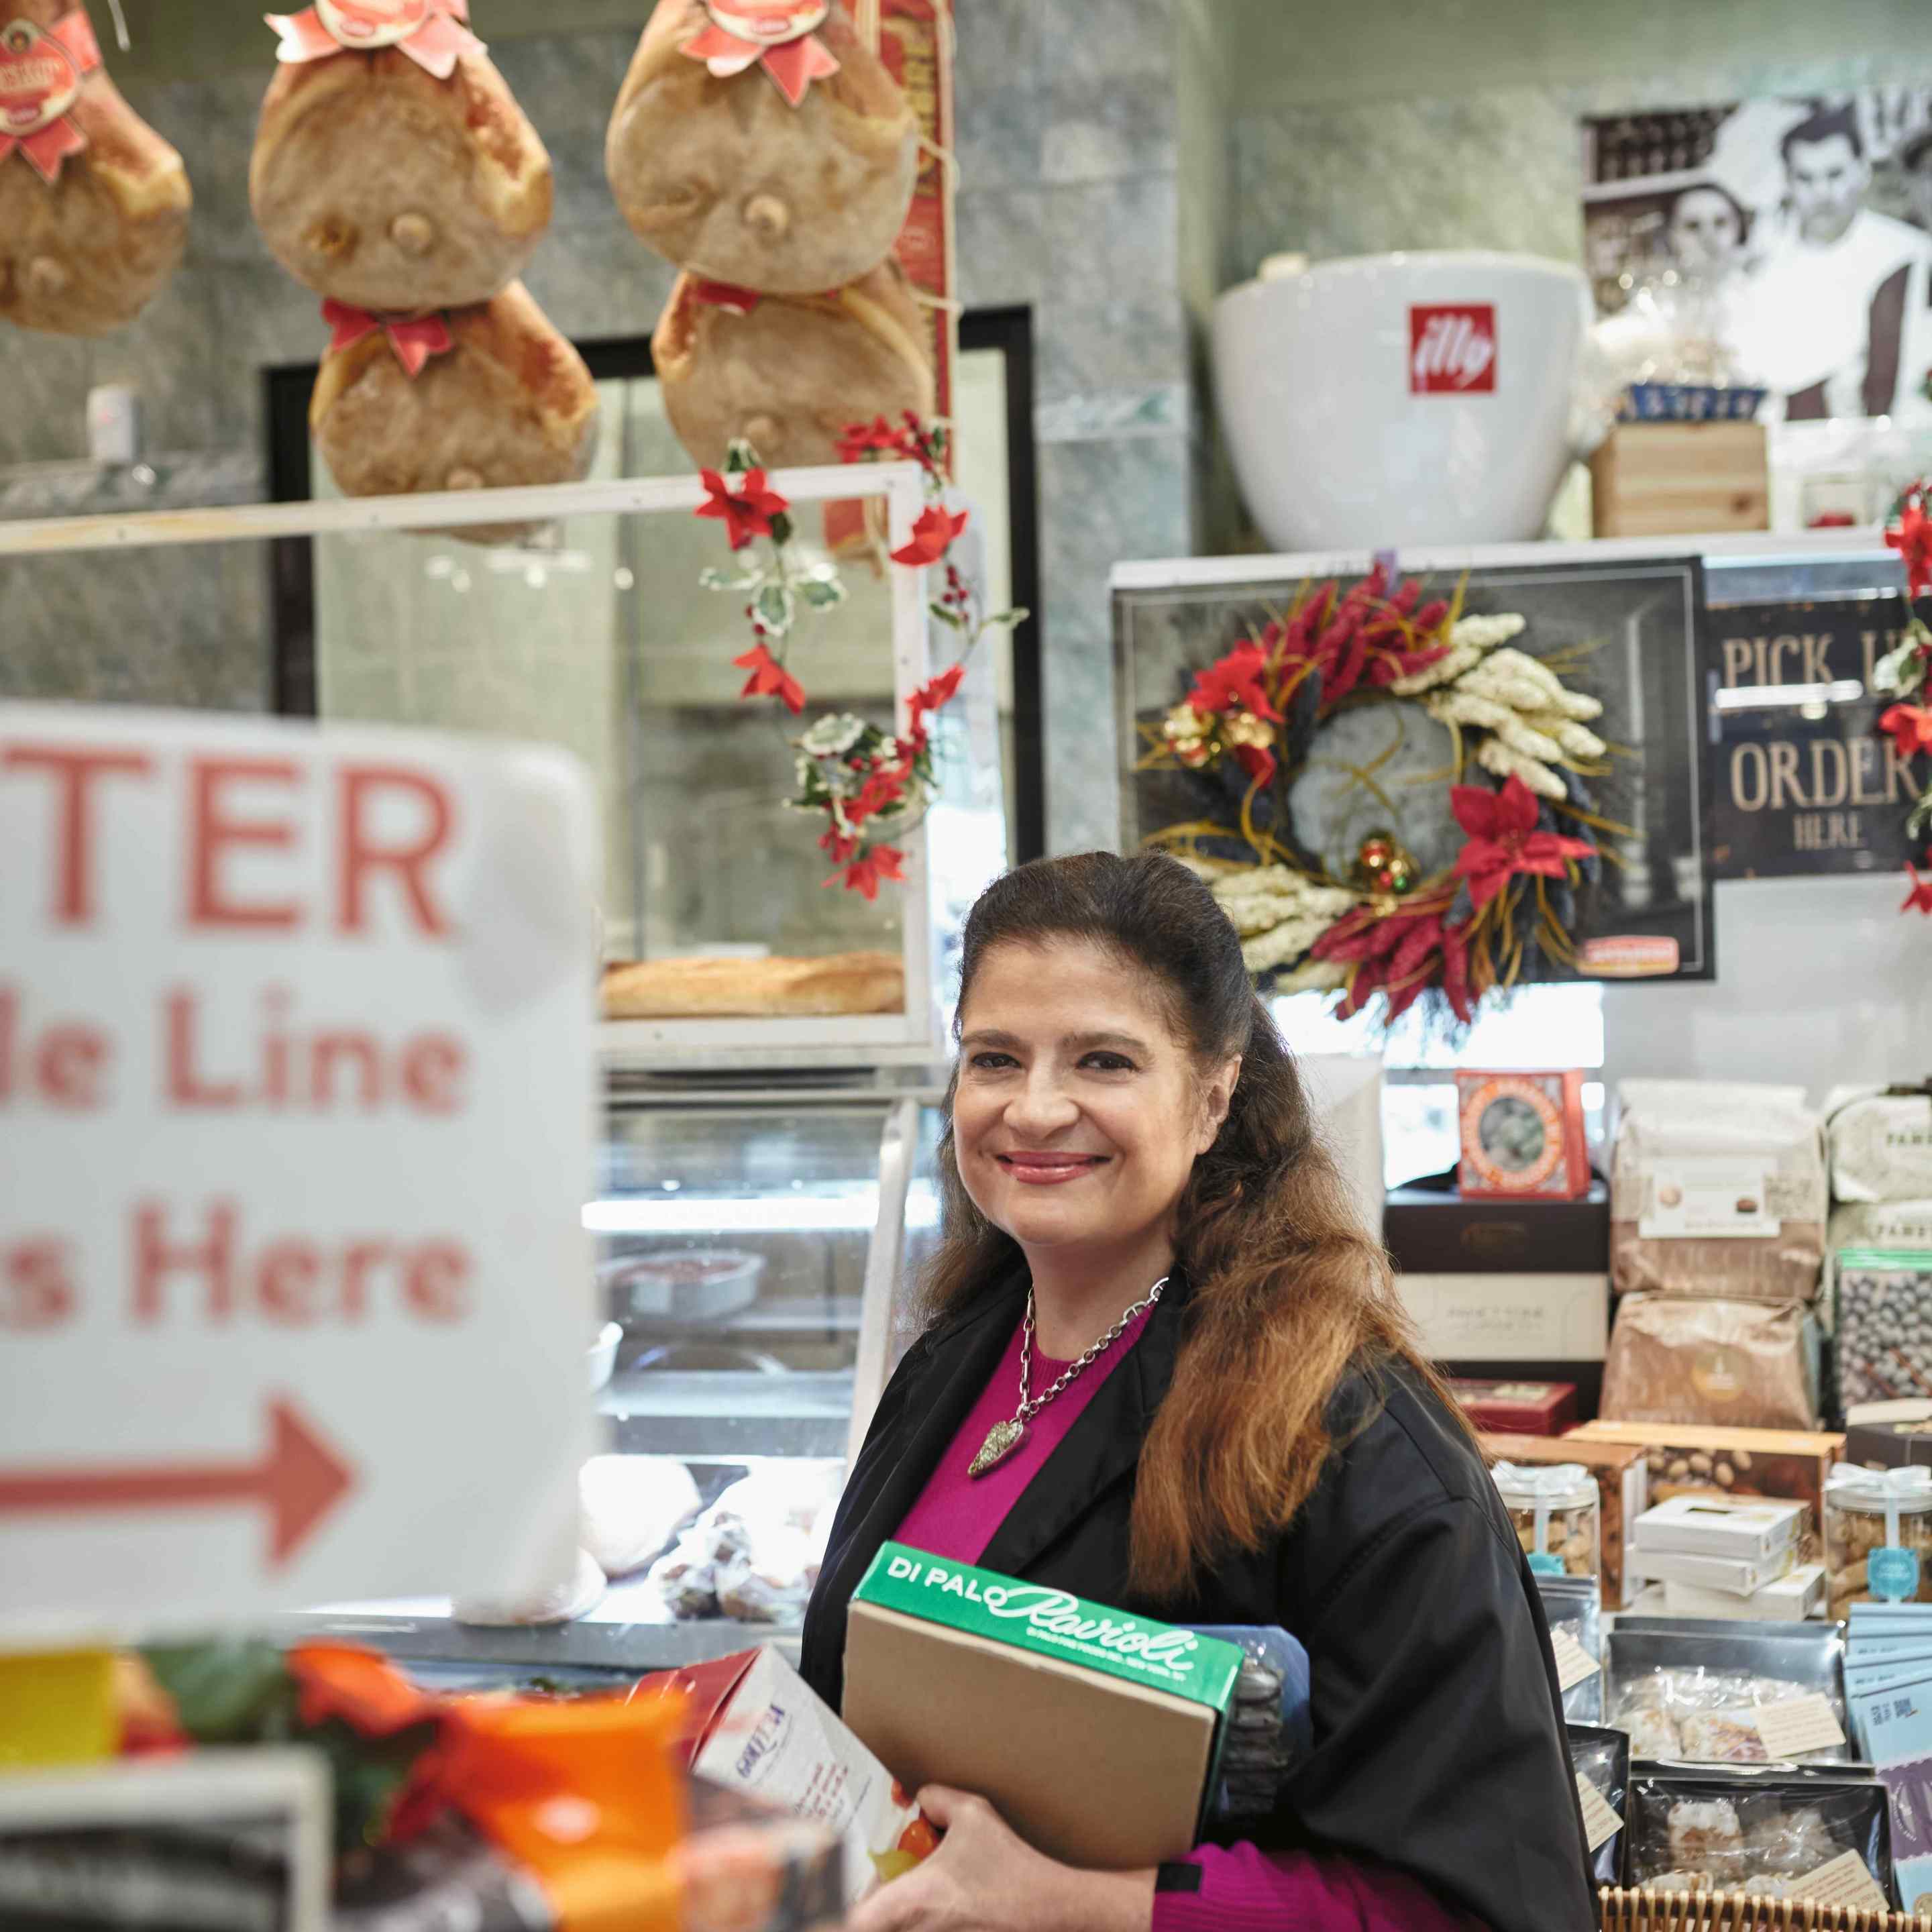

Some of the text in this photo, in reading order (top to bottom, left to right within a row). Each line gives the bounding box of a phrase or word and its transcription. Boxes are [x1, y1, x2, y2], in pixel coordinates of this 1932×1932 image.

[1414, 313, 1493, 389] illy
[1721, 633, 1834, 711] PICK
[1730, 735, 1924, 813] ORDER
[161, 979, 468, 1116] Line
[125, 1197, 474, 1328] Here
[887, 1556, 1199, 1671] DI PALO Ravioli
